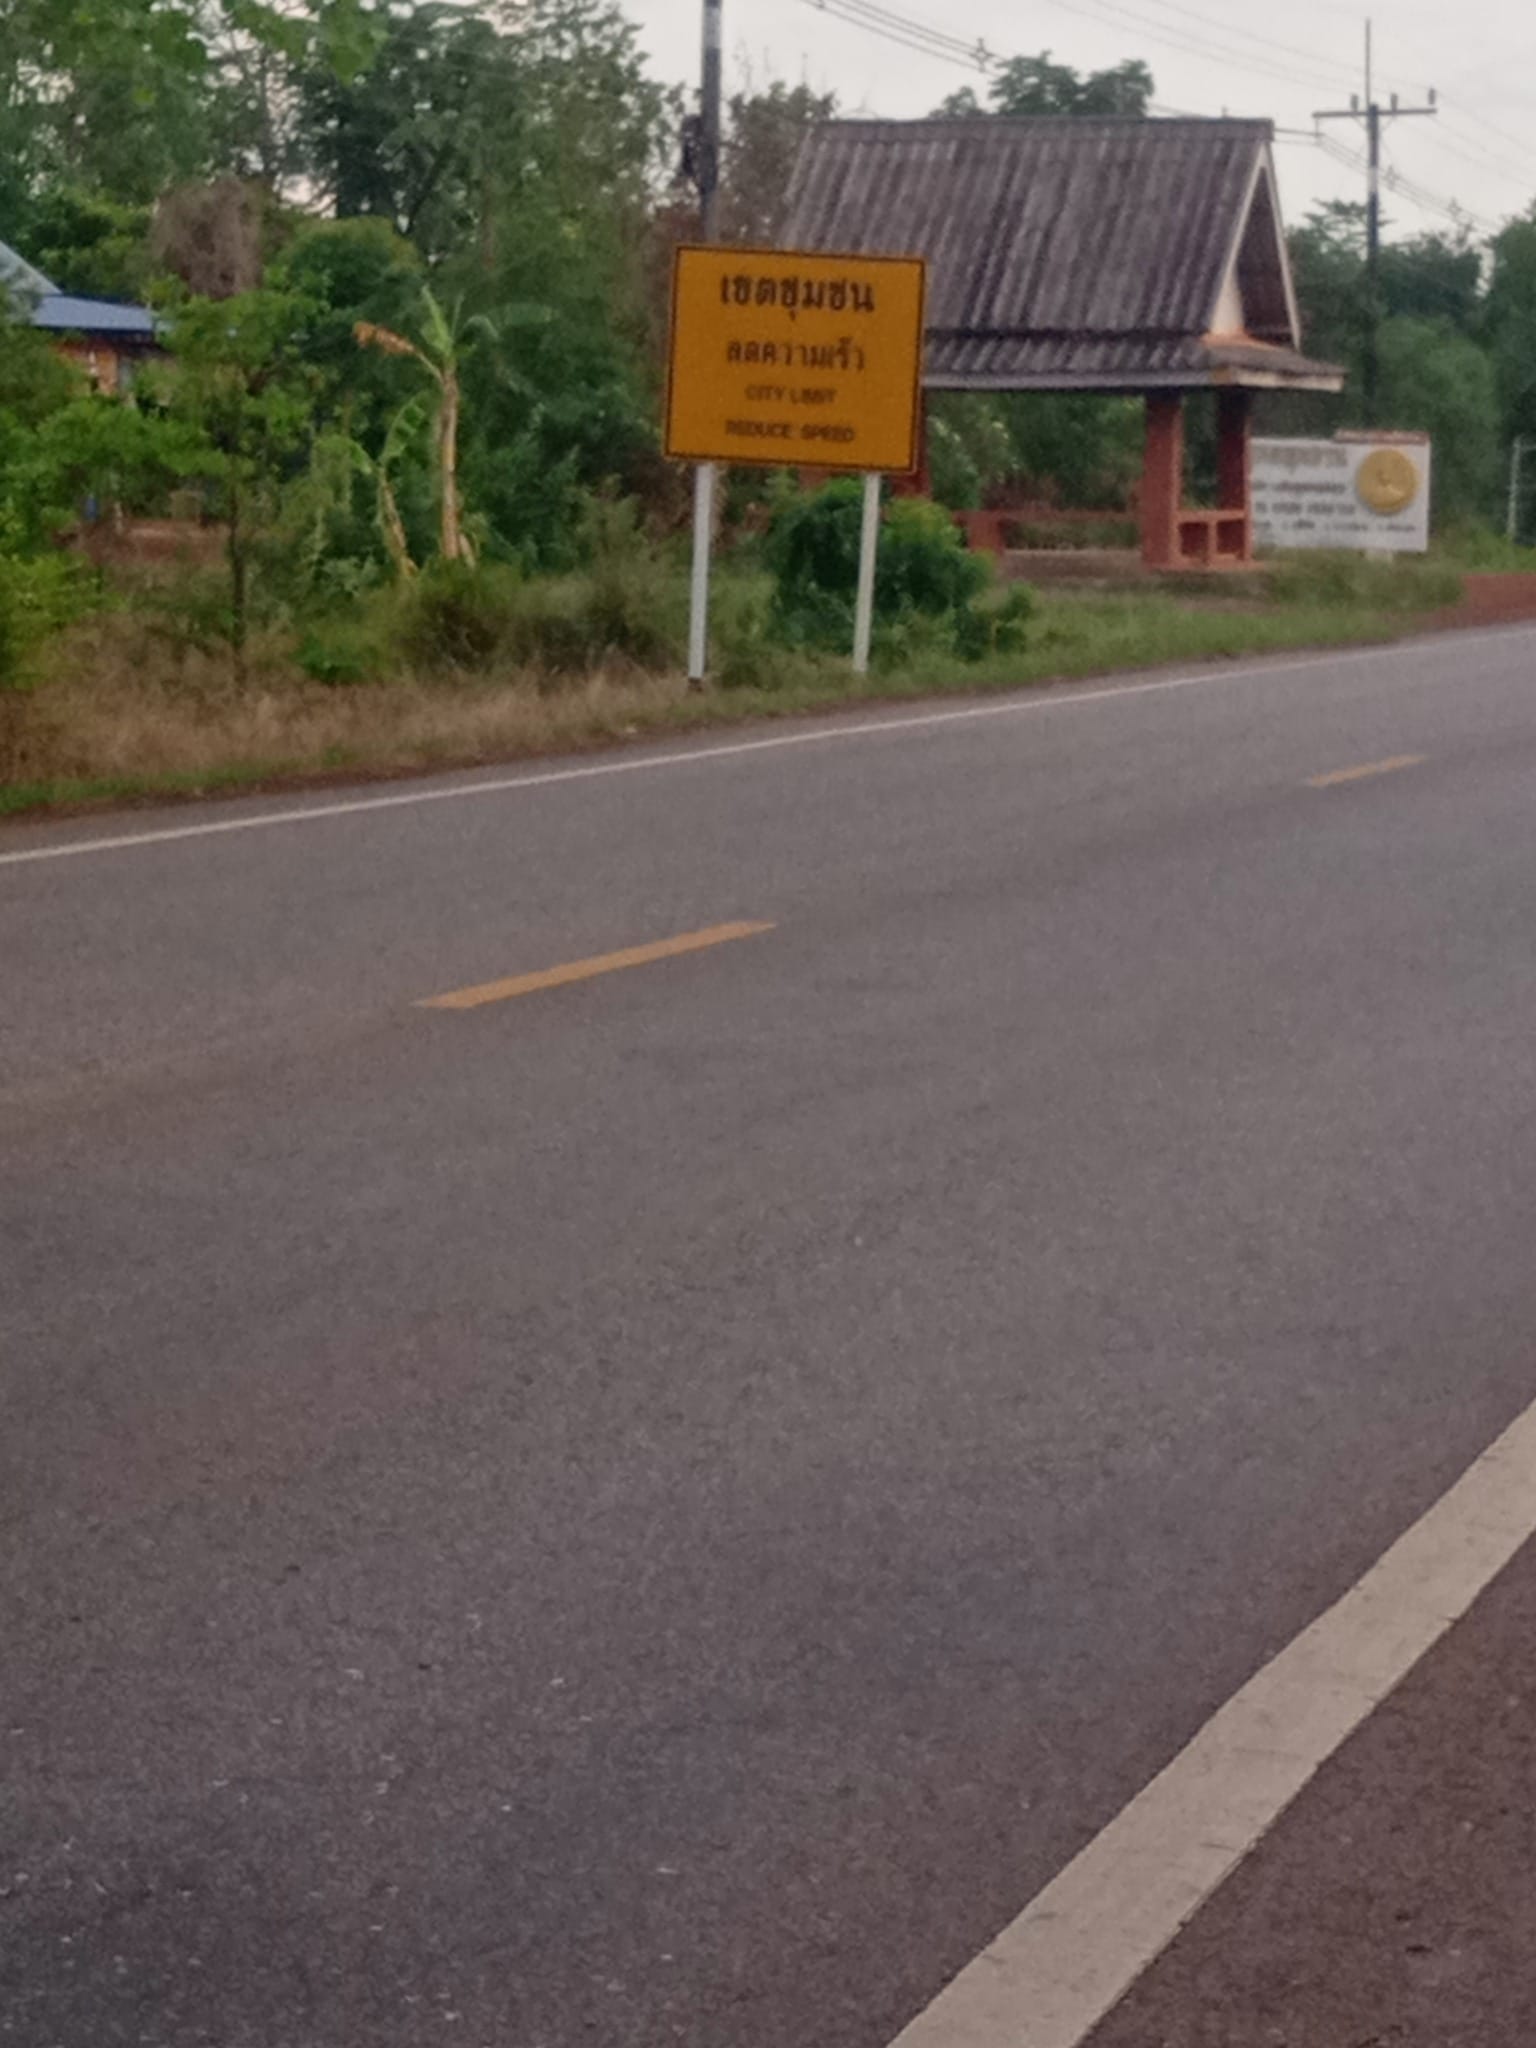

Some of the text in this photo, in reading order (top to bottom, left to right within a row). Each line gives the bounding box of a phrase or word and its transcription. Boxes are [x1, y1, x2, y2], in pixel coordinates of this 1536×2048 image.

[721, 275, 875, 321] เขตชุมชน
[727, 336, 866, 371] ลดความเร็ว
[745, 384, 837, 404] CITY LIMIT
[725, 419, 855, 442] REDUCE SPEED
